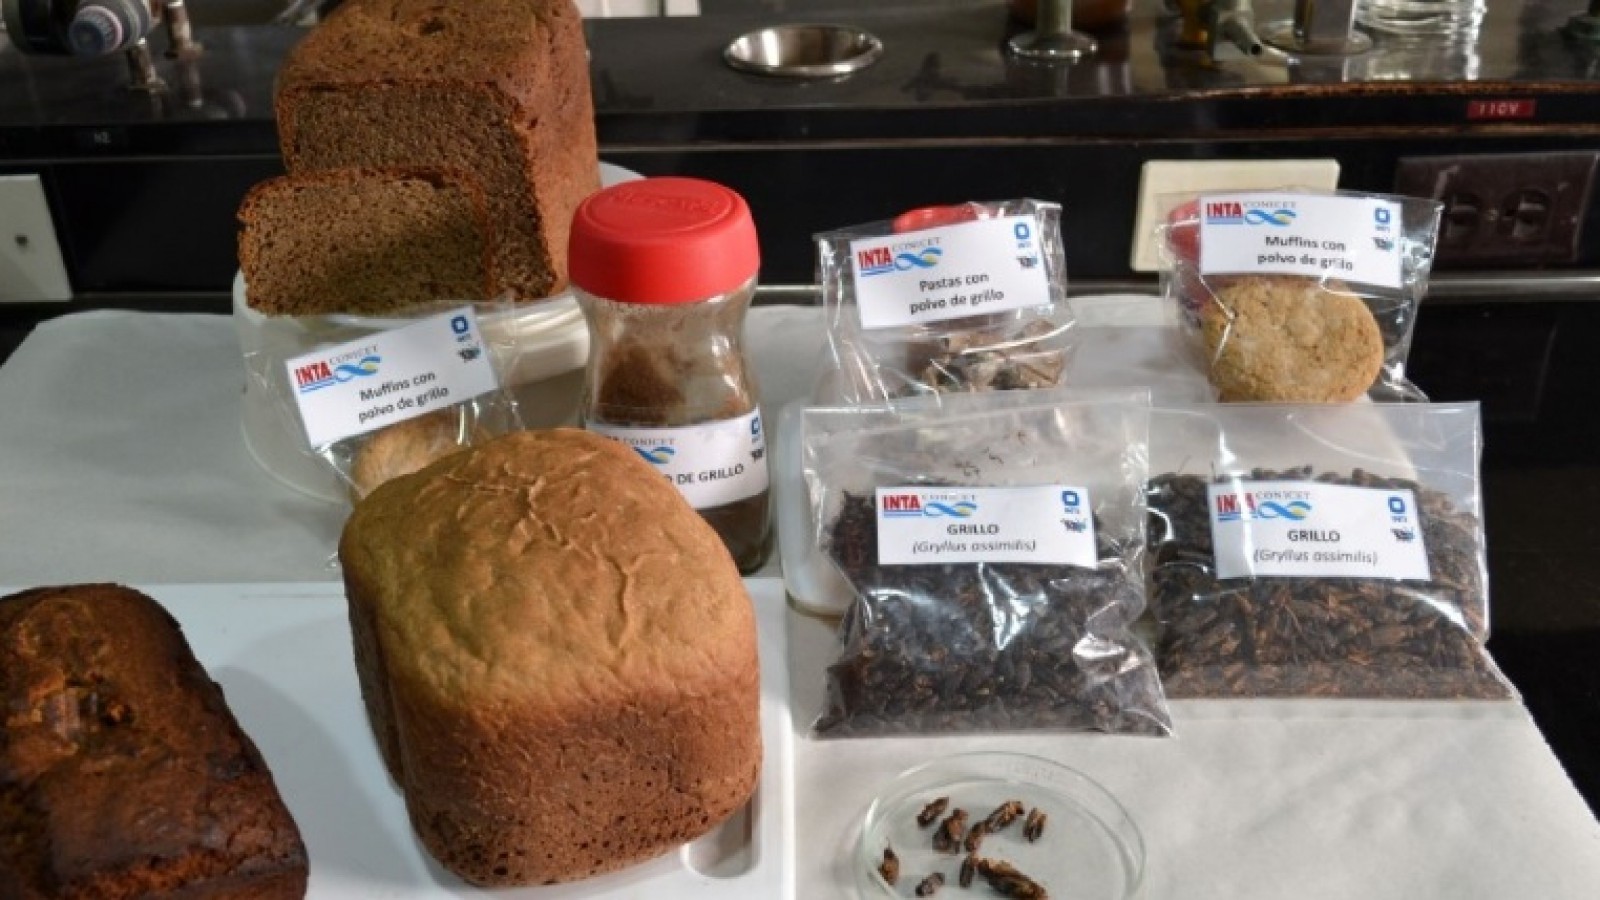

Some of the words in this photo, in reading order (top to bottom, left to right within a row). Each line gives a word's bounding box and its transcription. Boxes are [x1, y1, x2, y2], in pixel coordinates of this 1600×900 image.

[1206, 203, 1243, 218] INTA
[1244, 199, 1297, 210] CONICET
[892, 236, 941, 253] CONICET
[1265, 235, 1320, 249] Muffins
[1322, 239, 1346, 252] con
[858, 247, 893, 270] INTA
[1257, 251, 1297, 265] polvo
[1299, 253, 1317, 266] de
[919, 276, 963, 293] Pastas
[965, 273, 990, 286] con
[910, 299, 947, 316] polvo
[950, 293, 968, 306] de
[969, 289, 1005, 307] grillo
[329, 343, 380, 366] CONICET
[295, 361, 333, 387] INTA
[359, 379, 411, 402] Muffins
[413, 371, 437, 388] con
[358, 404, 396, 425] polvo
[396, 397, 415, 411] de
[416, 386, 450, 408] grillo
[624, 437, 675, 447] CONICET
[678, 473, 696, 485] DE
[698, 463, 745, 483] GRILLO
[883, 494, 921, 510] INTA
[921, 493, 977, 502] CONICET
[1216, 492, 1256, 512] INA
[1256, 490, 1312, 501] CONICET
[946, 523, 1001, 536] GRILLO
[1287, 529, 1341, 542] GRILLO
[912, 541, 967, 555] (Gryllus
[971, 538, 1037, 553] assimilis)
[1253, 548, 1309, 563] (Gryllus
[1312, 549, 1378, 566] assimilis)
